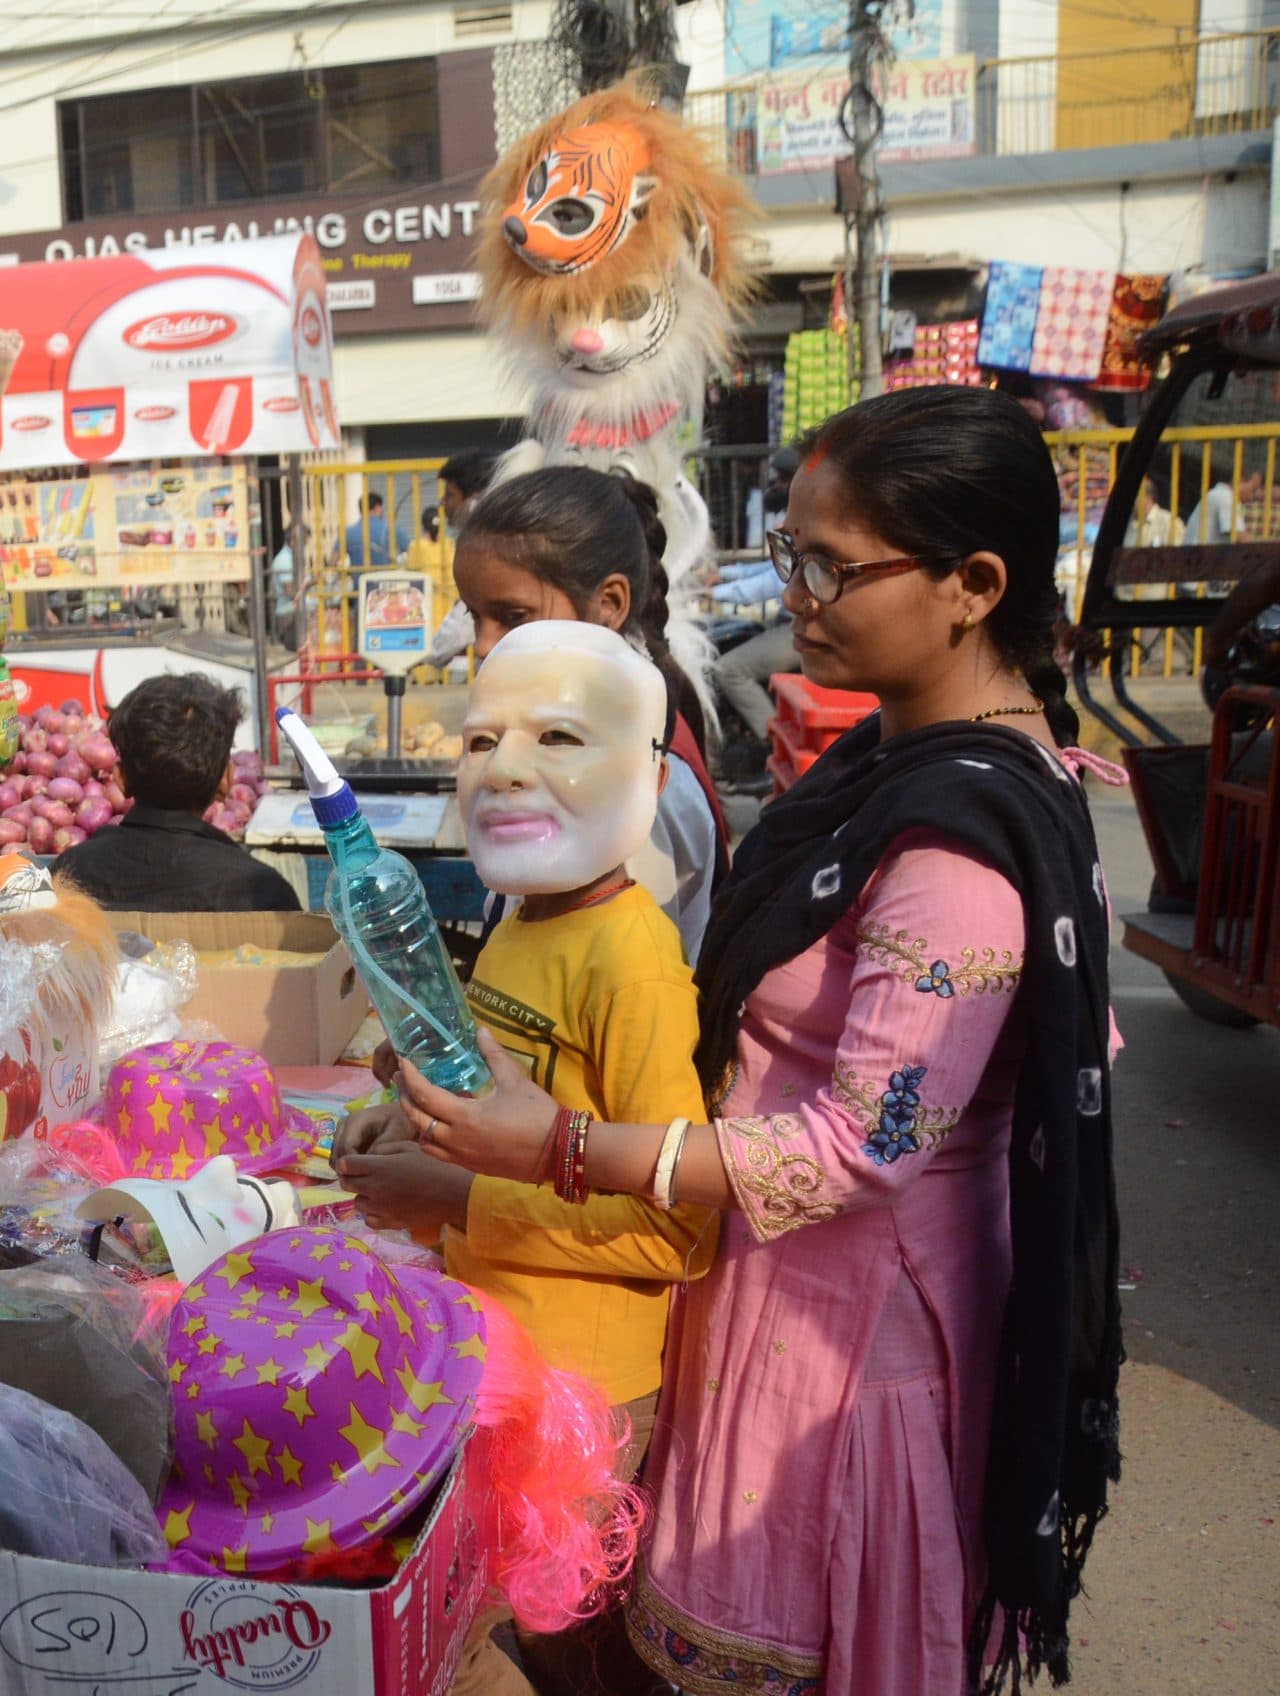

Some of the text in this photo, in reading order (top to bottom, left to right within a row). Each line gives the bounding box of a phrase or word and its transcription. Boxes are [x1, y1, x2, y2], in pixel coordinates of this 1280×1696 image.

[351, 252, 412, 270] Therapy
[480, 989, 507, 1011] YORK
[204, 1583, 258, 1604] APPLES
[180, 1599, 332, 1679] Quality
[251, 1653, 304, 1680] PREMIUM
